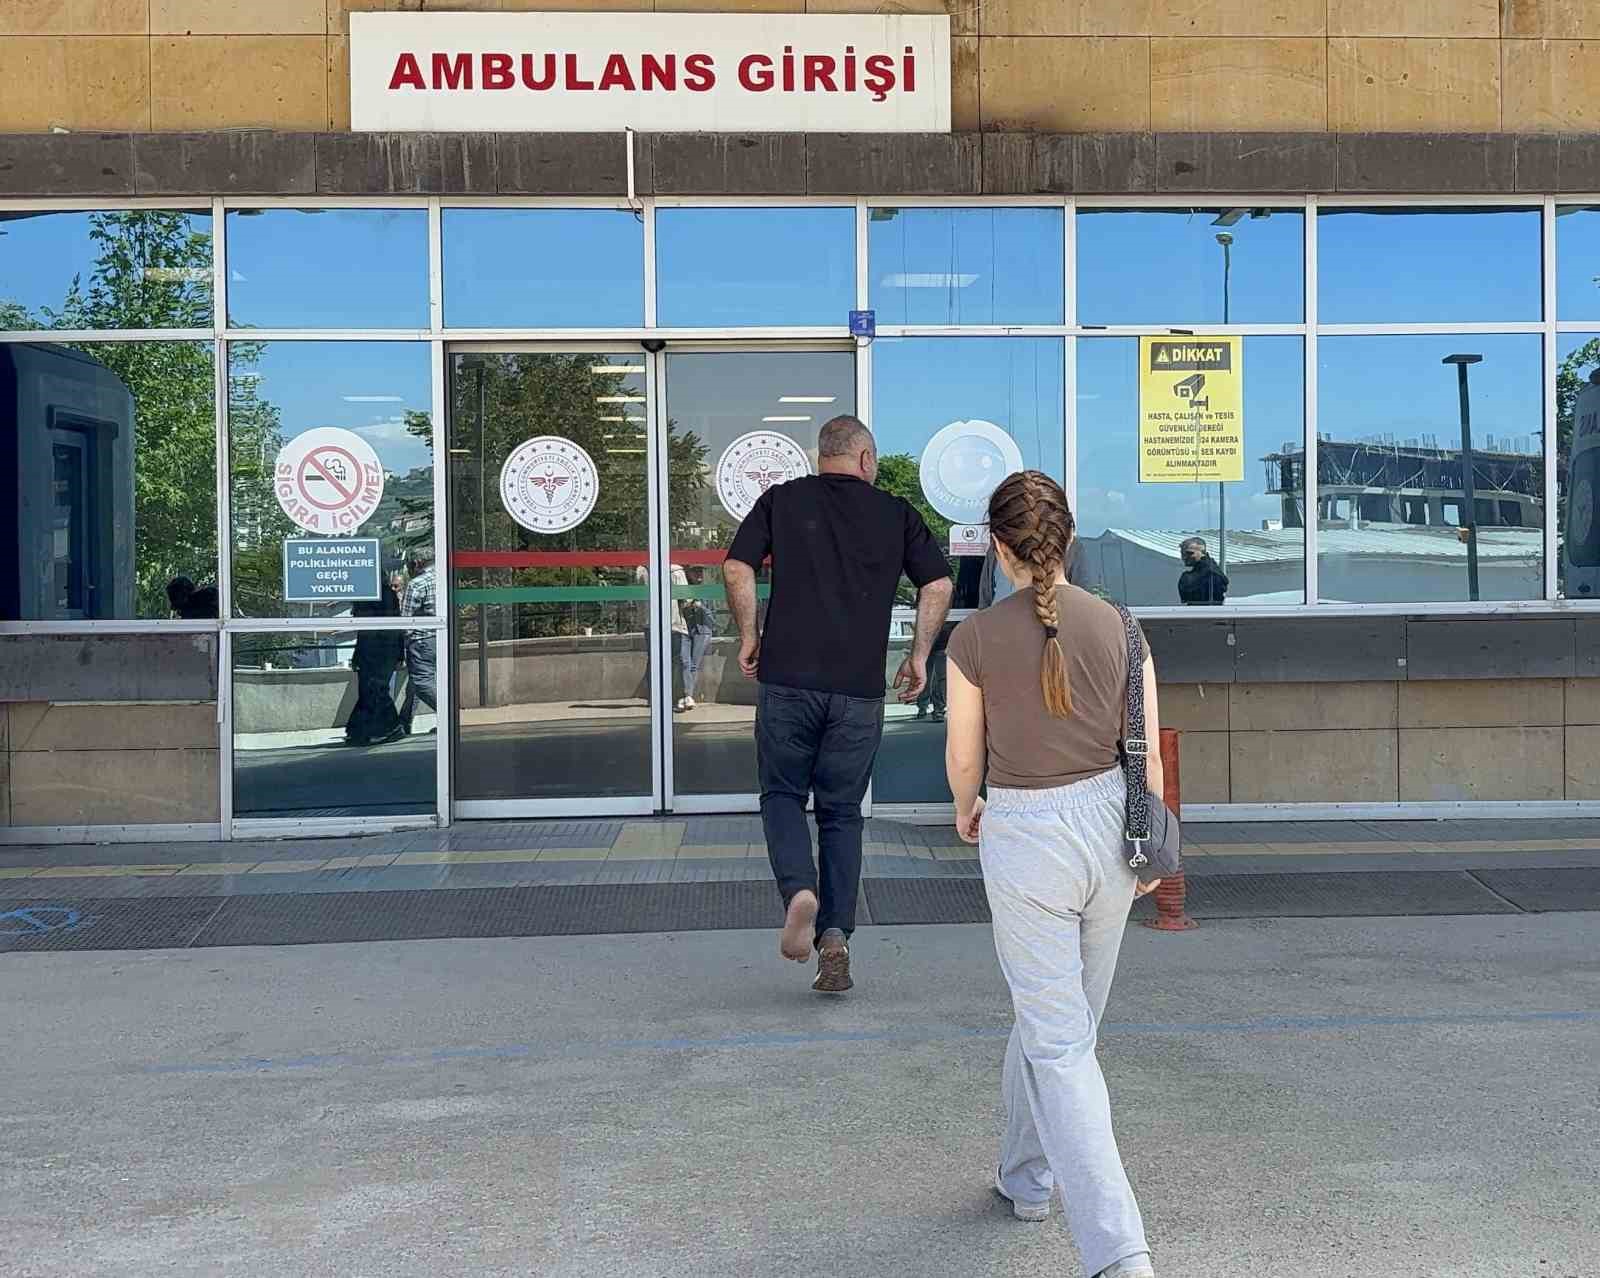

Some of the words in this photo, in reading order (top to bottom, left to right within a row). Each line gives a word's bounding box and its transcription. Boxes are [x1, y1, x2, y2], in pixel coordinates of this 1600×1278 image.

[388, 52, 717, 92] AMBULANS
[738, 46, 915, 102] GİRİŞİ
[1172, 345, 1223, 362] DİKKAT
[1210, 435, 1239, 444] KAMERA
[277, 463, 319, 528] SİGARA
[332, 460, 380, 529] İÇİLMEZ
[298, 546, 313, 555] BU
[316, 545, 366, 554] ALANDAN
[290, 558, 375, 568] POLİKLİNİKLERE
[316, 569, 349, 580] GEÇİŞ
[310, 584, 355, 593] YOKTUR
